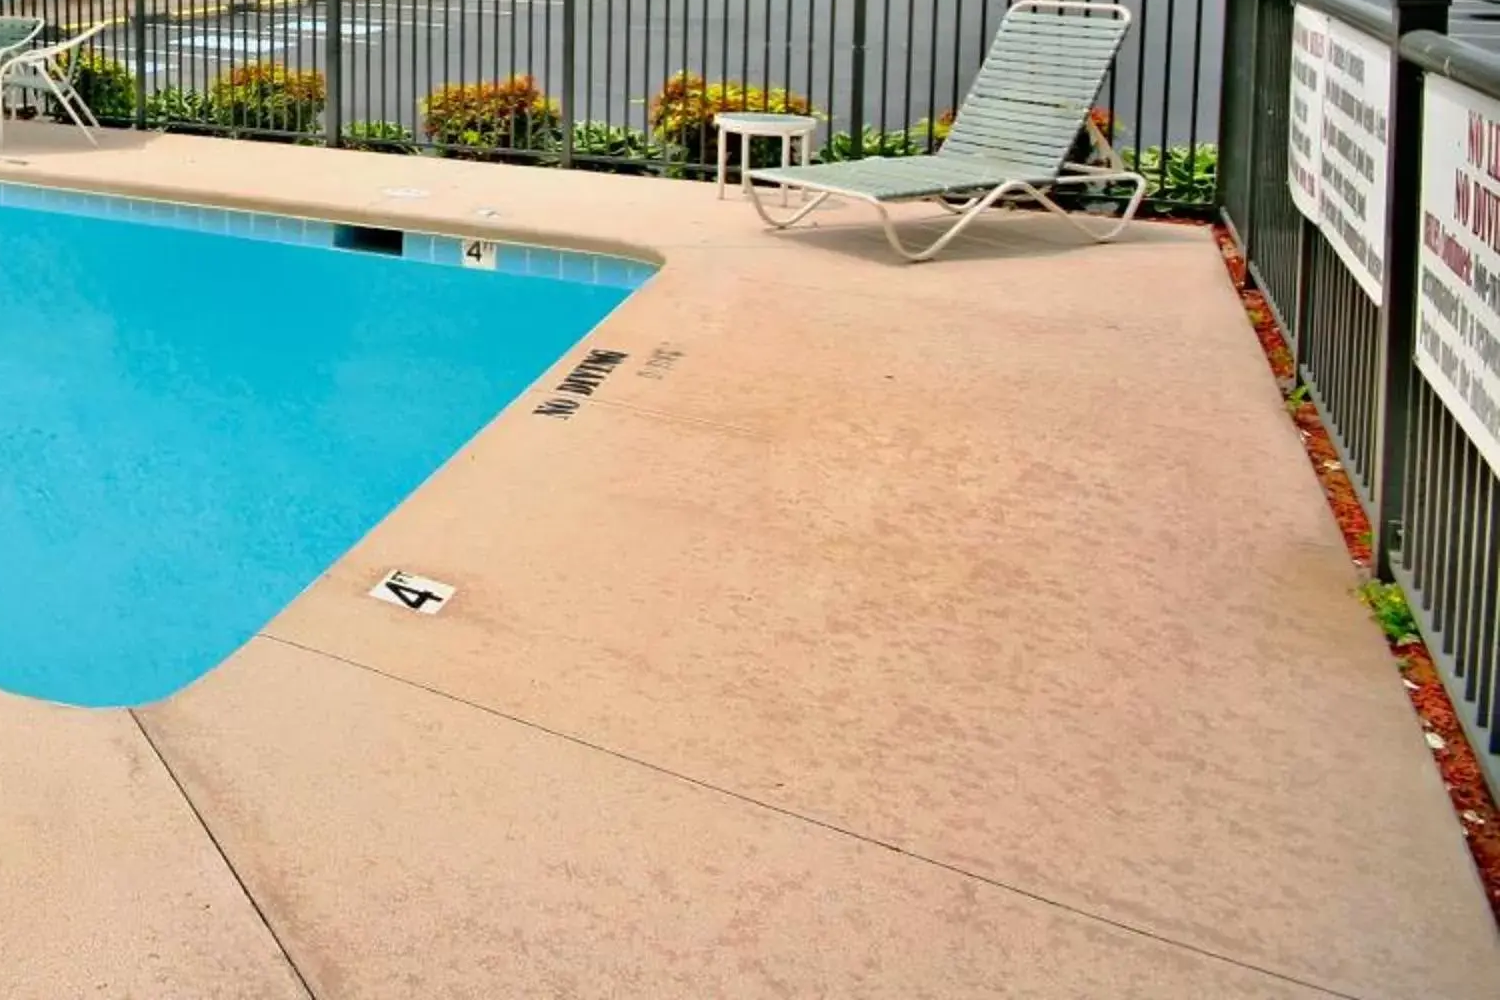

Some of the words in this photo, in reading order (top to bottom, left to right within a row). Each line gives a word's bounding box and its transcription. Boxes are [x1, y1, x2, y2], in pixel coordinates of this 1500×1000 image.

[1467, 109, 1483, 169] NO
[1453, 167, 1470, 226] NO
[466, 239, 482, 262] 4
[555, 348, 629, 397] DIVING
[532, 399, 581, 420] NO
[384, 581, 444, 609] 4
